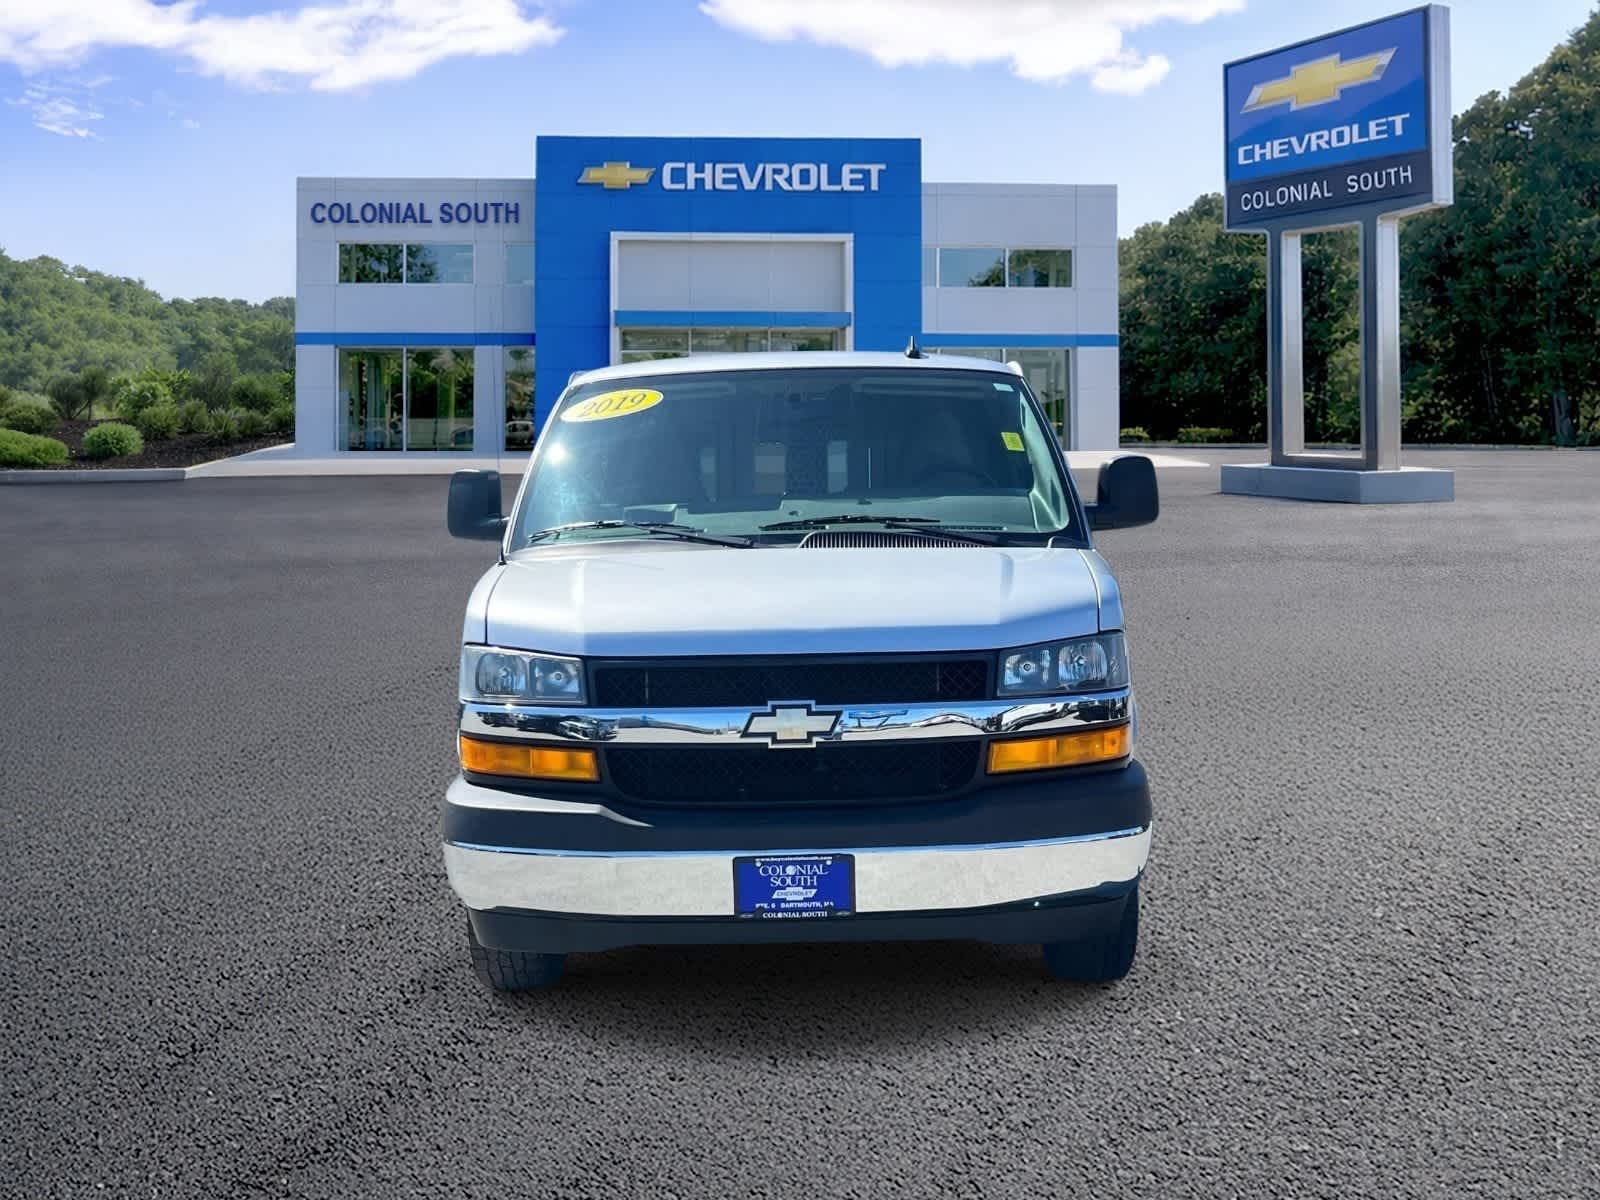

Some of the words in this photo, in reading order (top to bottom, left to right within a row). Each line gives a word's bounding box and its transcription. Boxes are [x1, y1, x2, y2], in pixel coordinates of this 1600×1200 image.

[1237, 112, 1411, 166] CHEVROLET
[661, 161, 887, 193] CHEVROLET
[1240, 179, 1333, 211] COLONIAL
[1346, 165, 1413, 194] SOUTH
[310, 202, 433, 225] COLONIAL
[439, 202, 521, 225] SOUTH
[578, 392, 647, 418] 2019
[759, 864, 831, 877] COLONIAL
[770, 875, 817, 887] SOUTH
